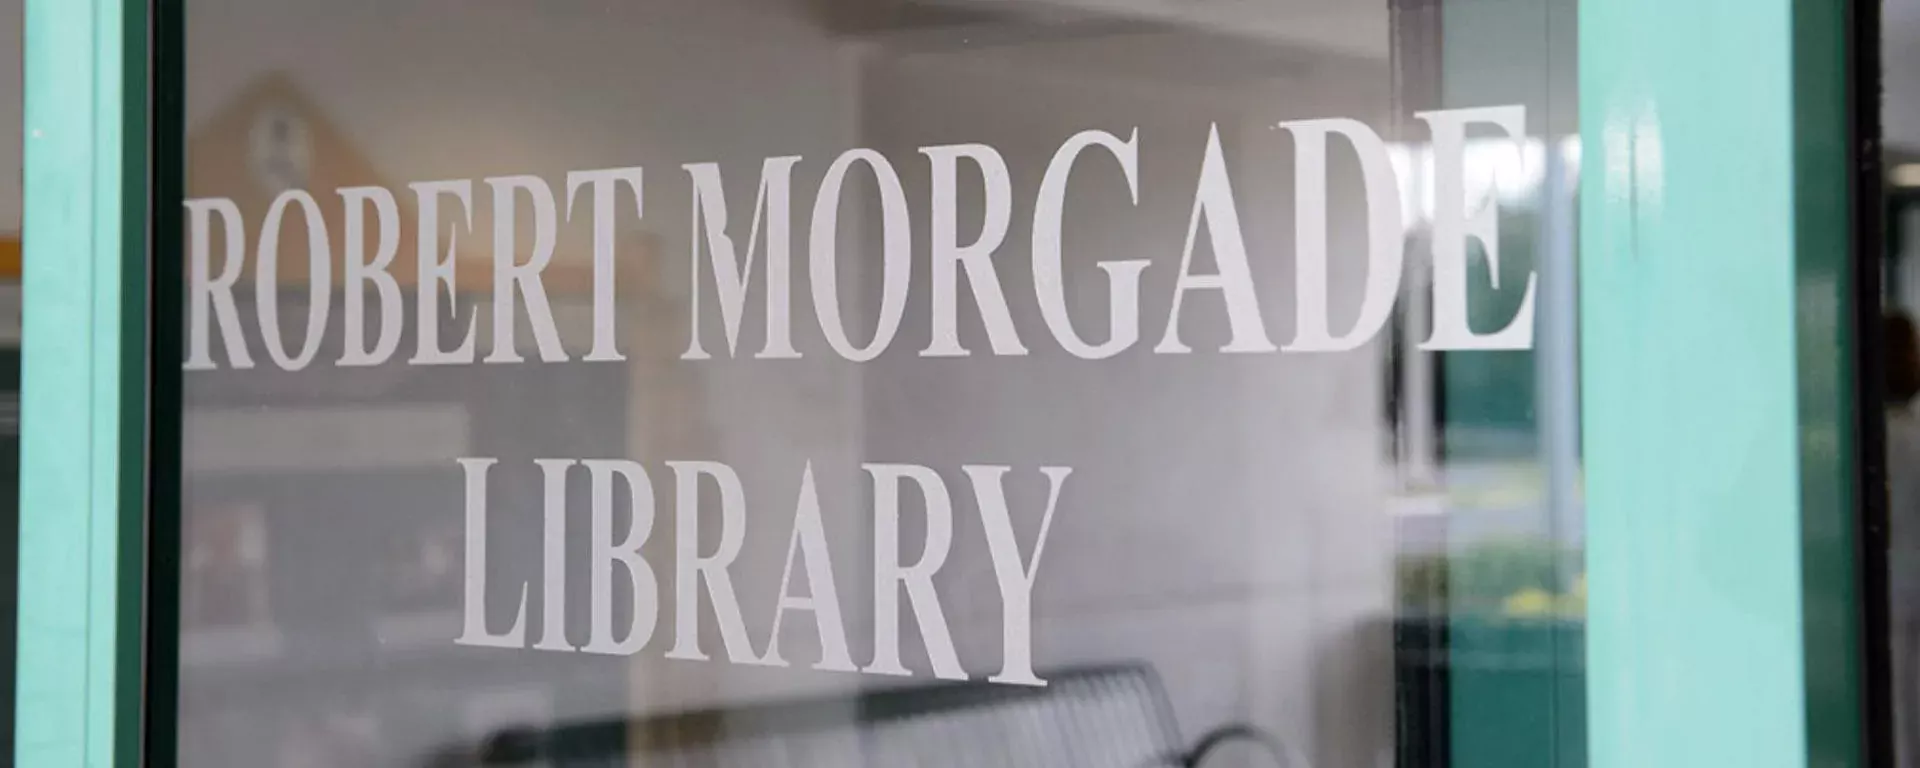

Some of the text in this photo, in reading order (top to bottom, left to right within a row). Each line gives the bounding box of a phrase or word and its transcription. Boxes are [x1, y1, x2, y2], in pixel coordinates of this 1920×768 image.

[183, 104, 1537, 371] ROBERT MORGADE
[454, 457, 1073, 686] LIBRARY
